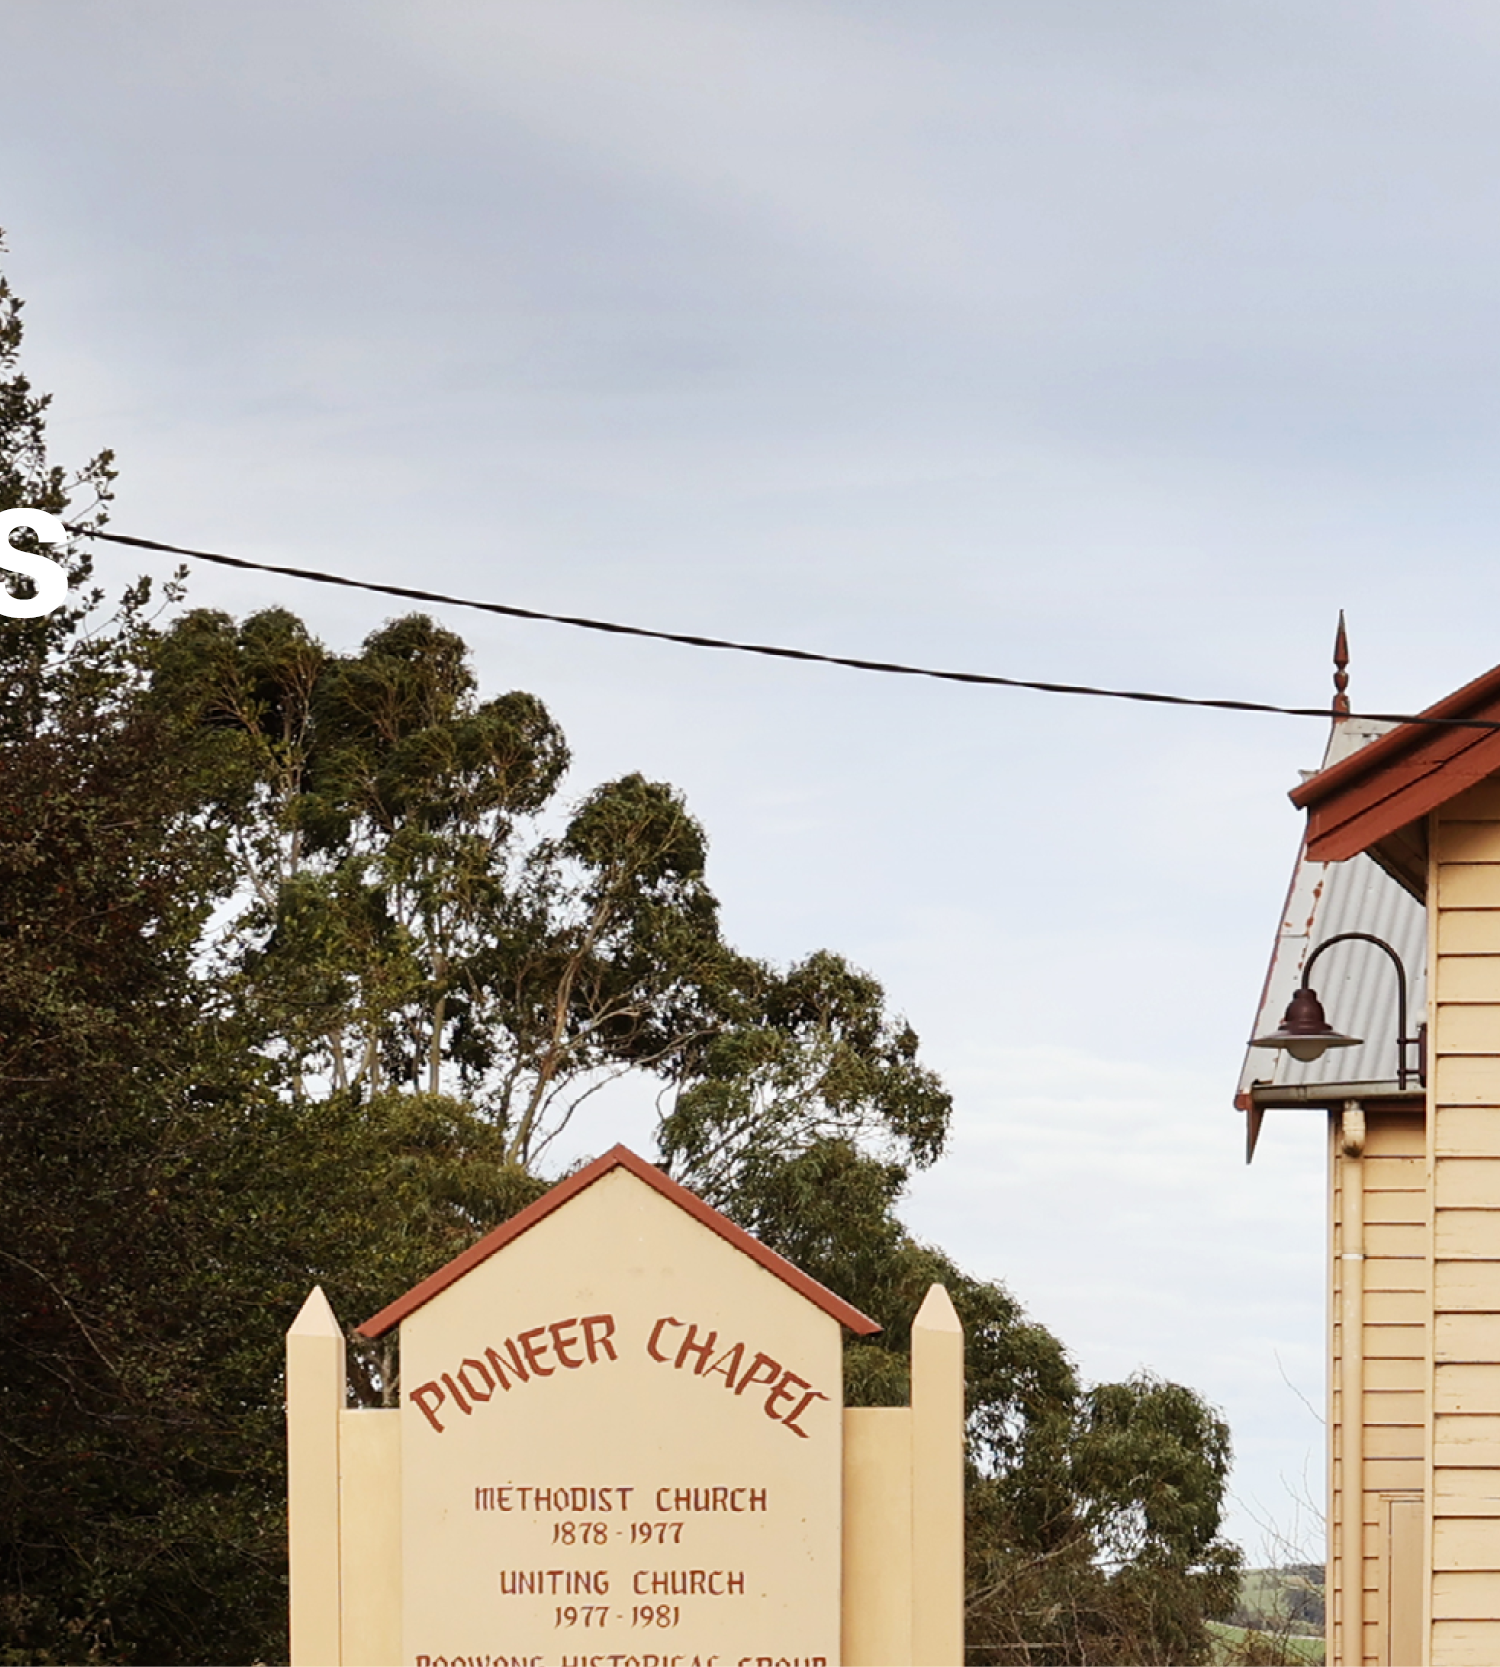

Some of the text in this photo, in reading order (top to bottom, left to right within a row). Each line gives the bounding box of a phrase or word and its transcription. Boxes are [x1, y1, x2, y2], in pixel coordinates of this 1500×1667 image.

[409, 1313, 831, 1440] PIONEER CHAPEL
[474, 1486, 768, 1513] METHODIST CHURCH
[551, 1520, 609, 1546] 1878
[629, 1521, 685, 1546] 1977
[499, 1569, 746, 1597] UNITING CHURCH
[553, 1604, 610, 1630] 1977
[630, 1604, 680, 1630] 1981
